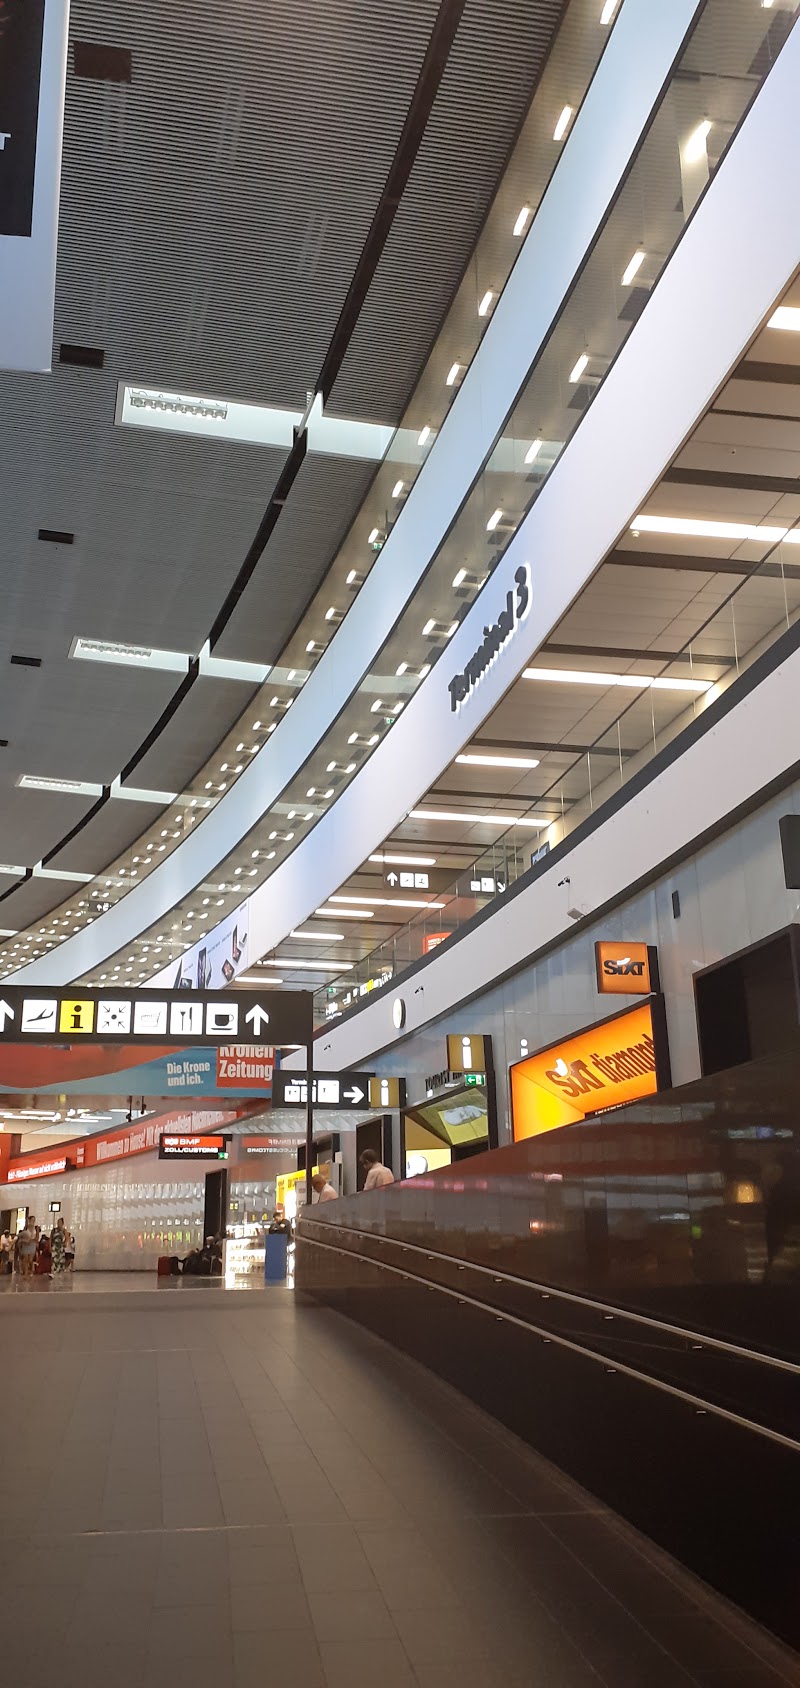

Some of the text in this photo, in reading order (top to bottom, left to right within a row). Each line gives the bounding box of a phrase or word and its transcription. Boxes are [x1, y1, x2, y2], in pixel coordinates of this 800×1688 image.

[448, 564, 532, 712] Terminal 3
[167, 1062, 211, 1075] Die Krone
[219, 1060, 273, 1081] Zeitung
[168, 1074, 204, 1087] und ich.
[179, 1138, 201, 1146] BMF
